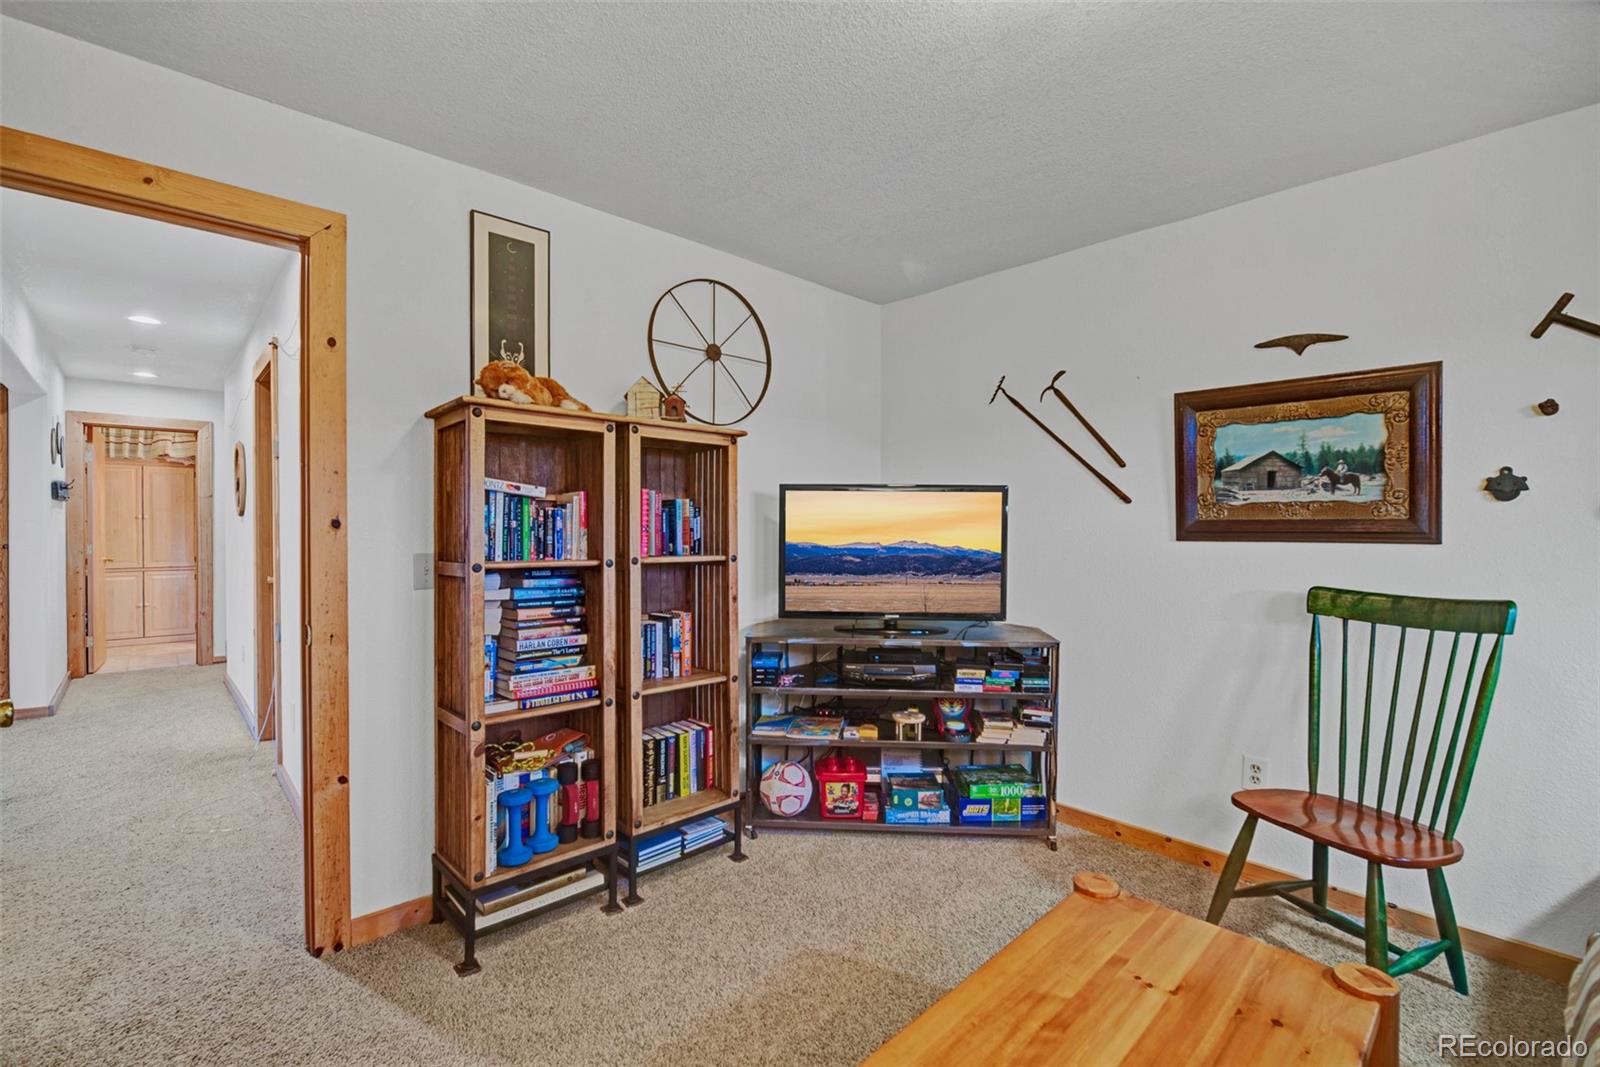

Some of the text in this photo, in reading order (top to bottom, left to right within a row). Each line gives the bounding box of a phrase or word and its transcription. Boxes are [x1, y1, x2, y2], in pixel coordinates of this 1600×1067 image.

[519, 641, 546, 650] HARLAN
[547, 639, 568, 648] COBEN
[1000, 786, 1023, 797] 1000
